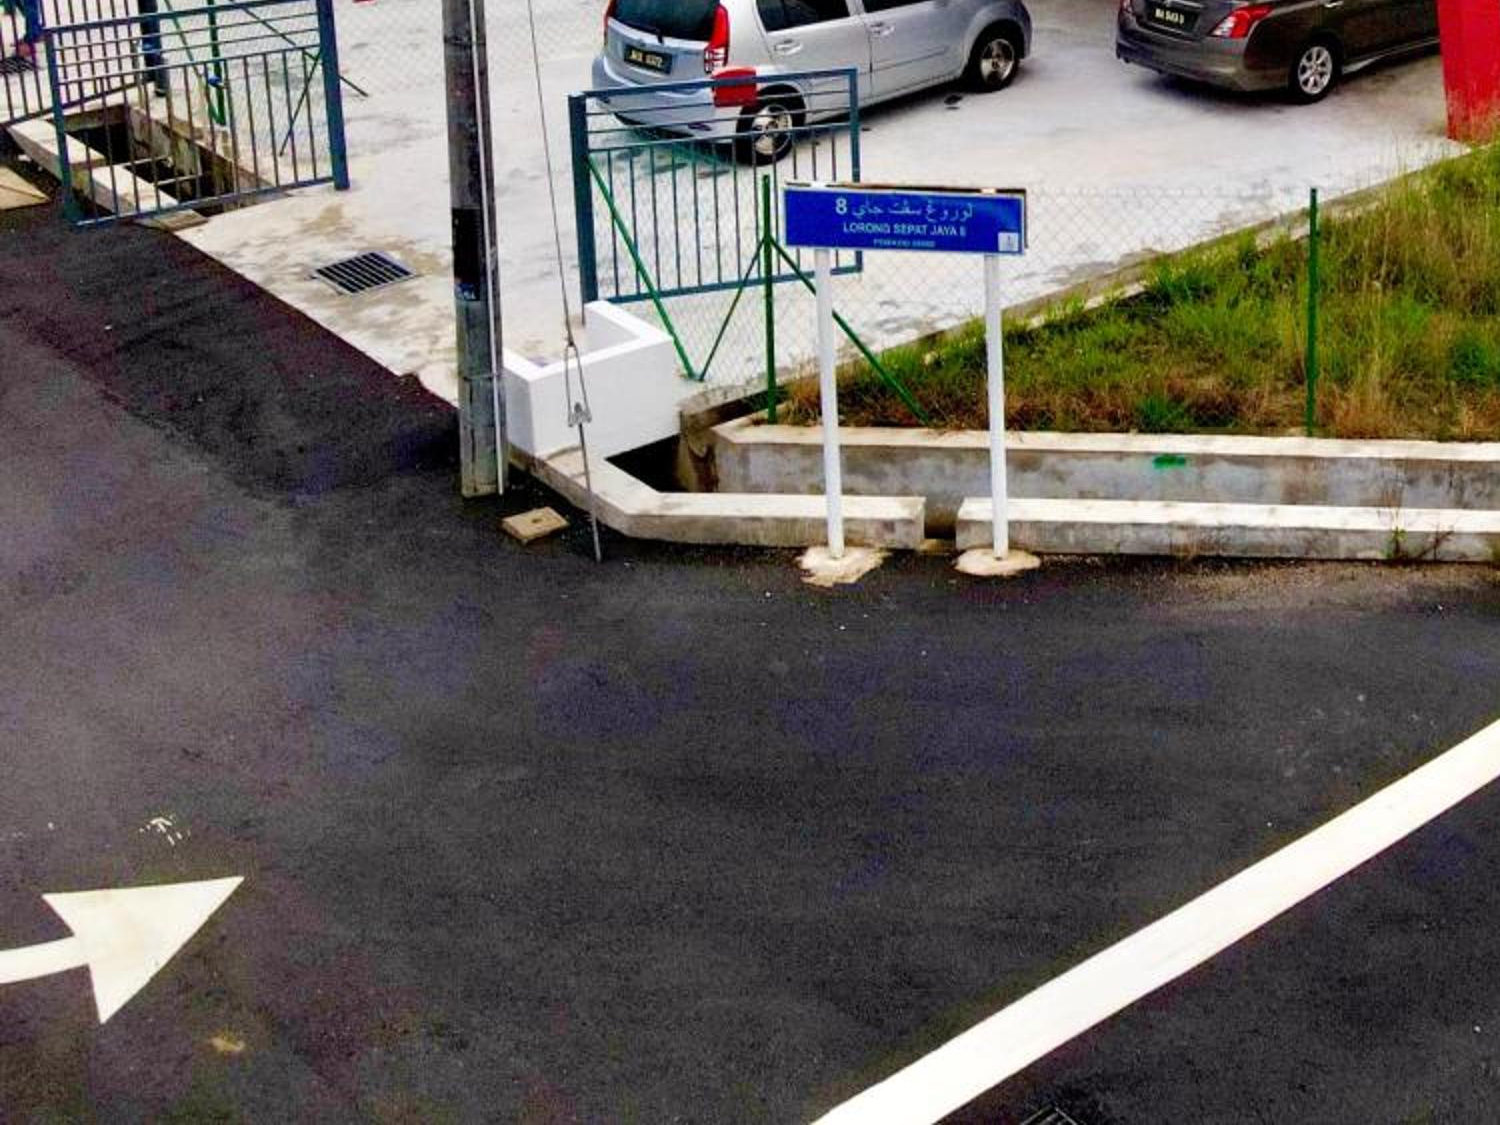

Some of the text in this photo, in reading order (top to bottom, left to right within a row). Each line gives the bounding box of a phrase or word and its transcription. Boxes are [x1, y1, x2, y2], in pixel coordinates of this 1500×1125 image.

[836, 197, 847, 214] 8
[843, 222, 890, 234] LORONG
[893, 223, 928, 235] SEPAT
[930, 225, 959, 236] JAYA
